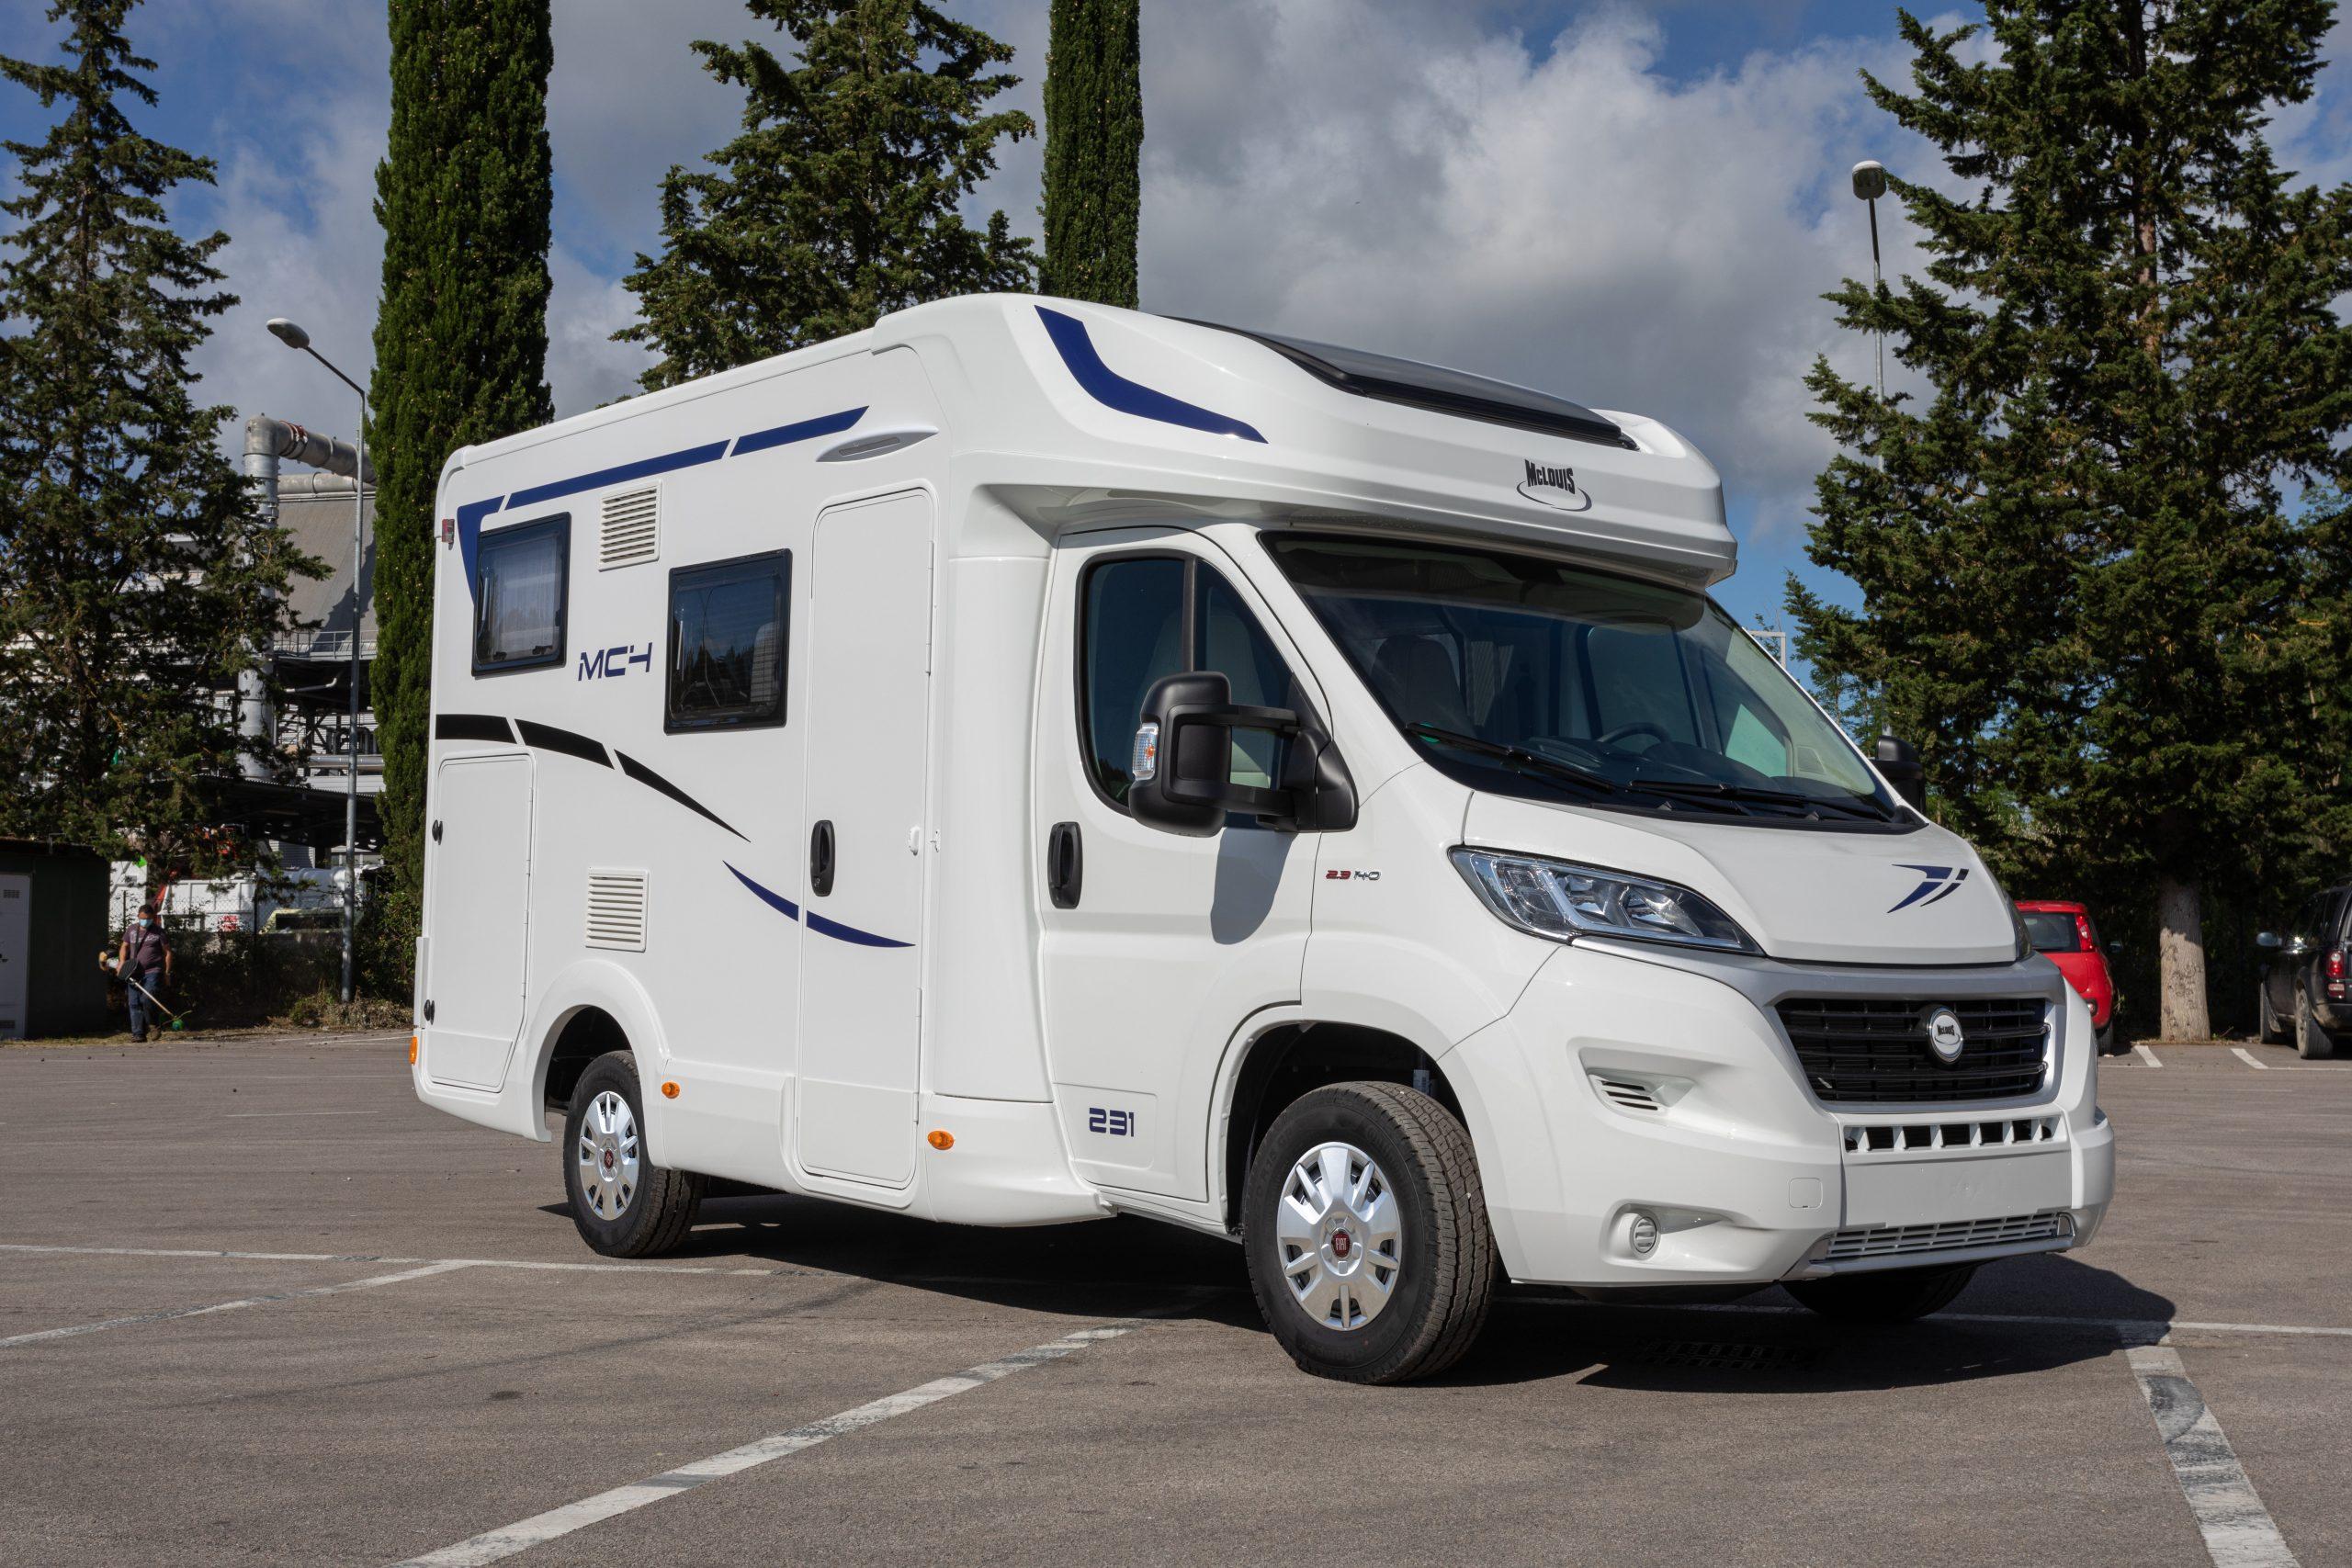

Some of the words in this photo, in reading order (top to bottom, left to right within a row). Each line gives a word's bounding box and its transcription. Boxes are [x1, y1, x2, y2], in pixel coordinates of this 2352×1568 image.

[578, 642, 653, 681] MC4
[1353, 870, 1382, 881] 140
[1089, 1107, 1135, 1137] 231
[1335, 1237, 1347, 1251] FIAT
